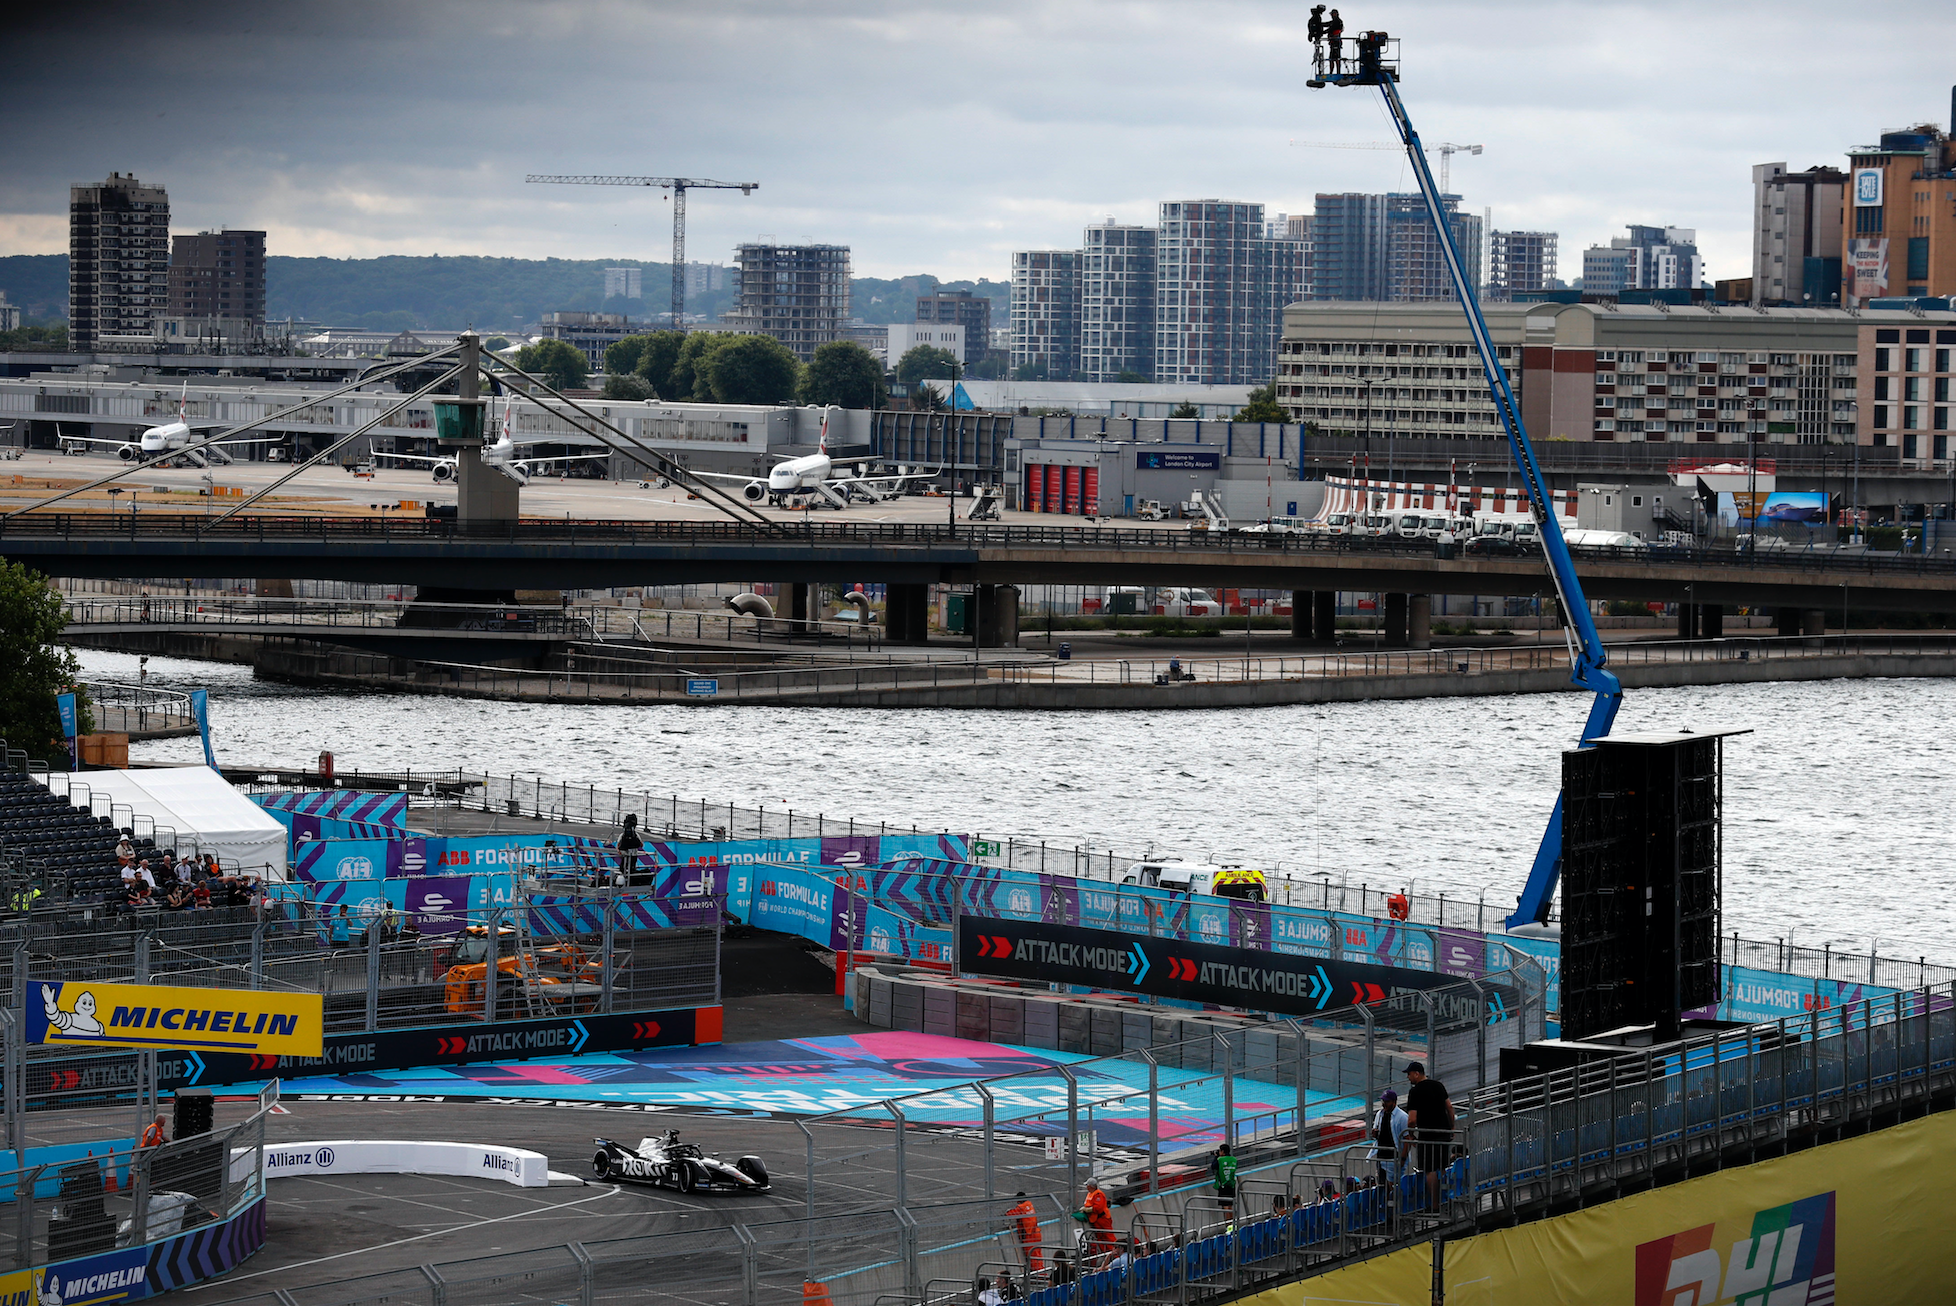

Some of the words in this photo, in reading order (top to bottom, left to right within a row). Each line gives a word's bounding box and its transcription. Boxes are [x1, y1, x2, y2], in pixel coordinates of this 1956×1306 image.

[1860, 176, 1877, 187] TATE
[1861, 187, 1876, 199] LYLE
[1856, 251, 1879, 259] KEEPING
[1857, 269, 1878, 278] SWEET
[437, 851, 470, 866] ABB
[760, 880, 777, 896] ABB
[778, 882, 819, 907] FORMULA
[821, 894, 827, 911] E
[769, 905, 788, 915] WORLD
[788, 907, 826, 926] CHAMPIONSHIP
[919, 942, 939, 959] ABB
[1015, 938, 1080, 967] ATTACK
[1083, 946, 1128, 973] MODE
[1200, 961, 1260, 992] ATTACK
[1262, 969, 1308, 998] MODE
[109, 1006, 298, 1035] MICHELIN
[467, 1031, 524, 1053] ATTACK
[525, 1029, 565, 1049] MODE
[336, 1043, 375, 1063] MODE
[80, 1065, 138, 1088] ATTACK
[267, 1152, 311, 1168] Allianz
[483, 1153, 513, 1172] Allianz
[64, 1265, 147, 1299] MICHELIN
